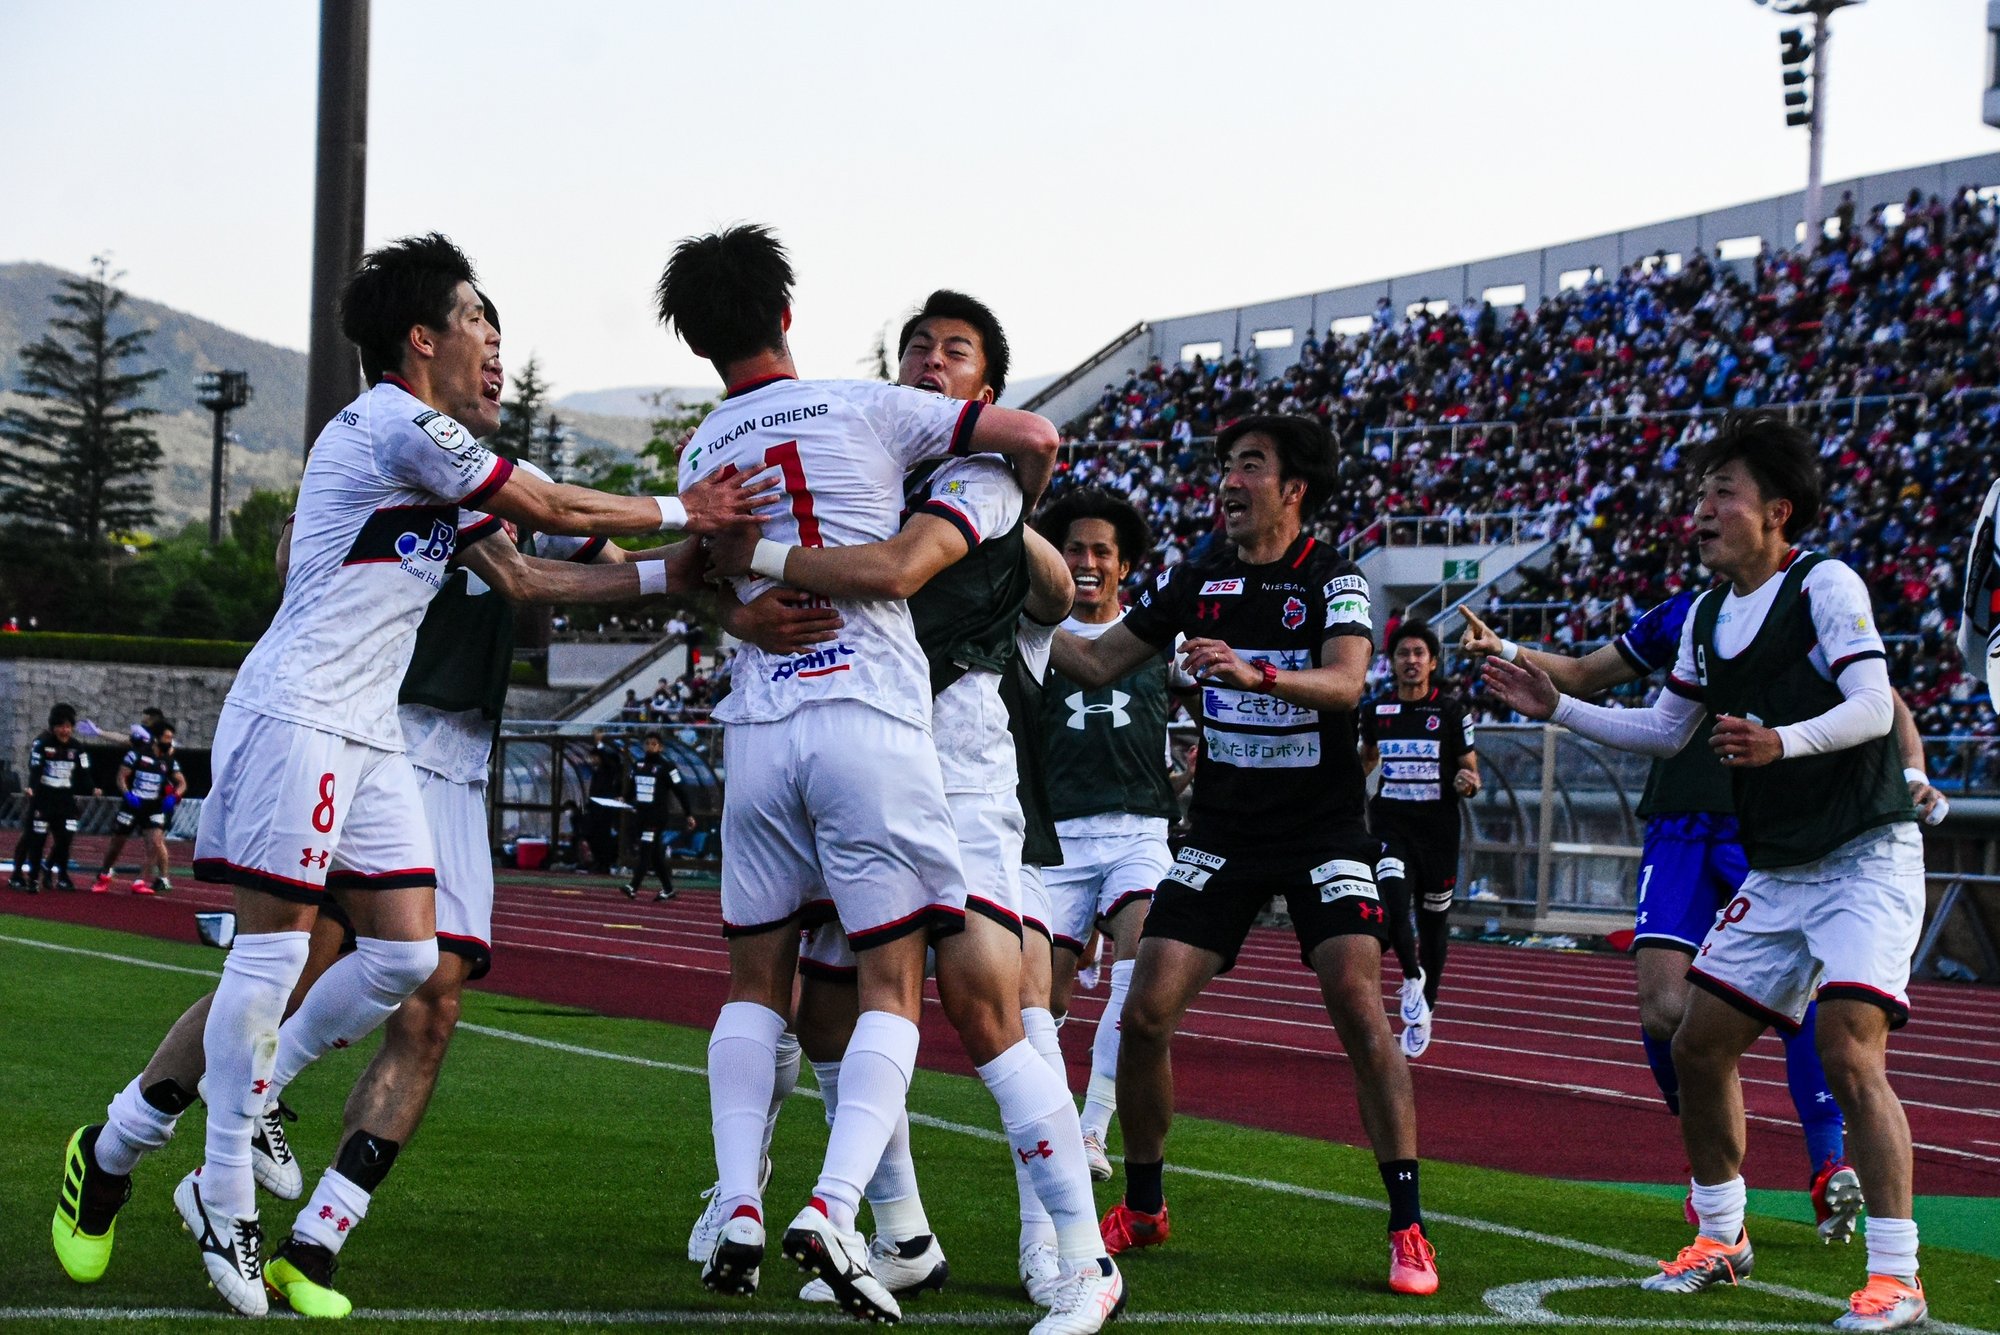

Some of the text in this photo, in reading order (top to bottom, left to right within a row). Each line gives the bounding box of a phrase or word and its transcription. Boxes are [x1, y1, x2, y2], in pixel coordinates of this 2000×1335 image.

[707, 403, 829, 455] TOKAN ORIENS
[399, 558, 427, 580] Banei
[1261, 582, 1306, 593] NISSAN
[1697, 643, 1708, 687] 9
[311, 772, 336, 834] 8
